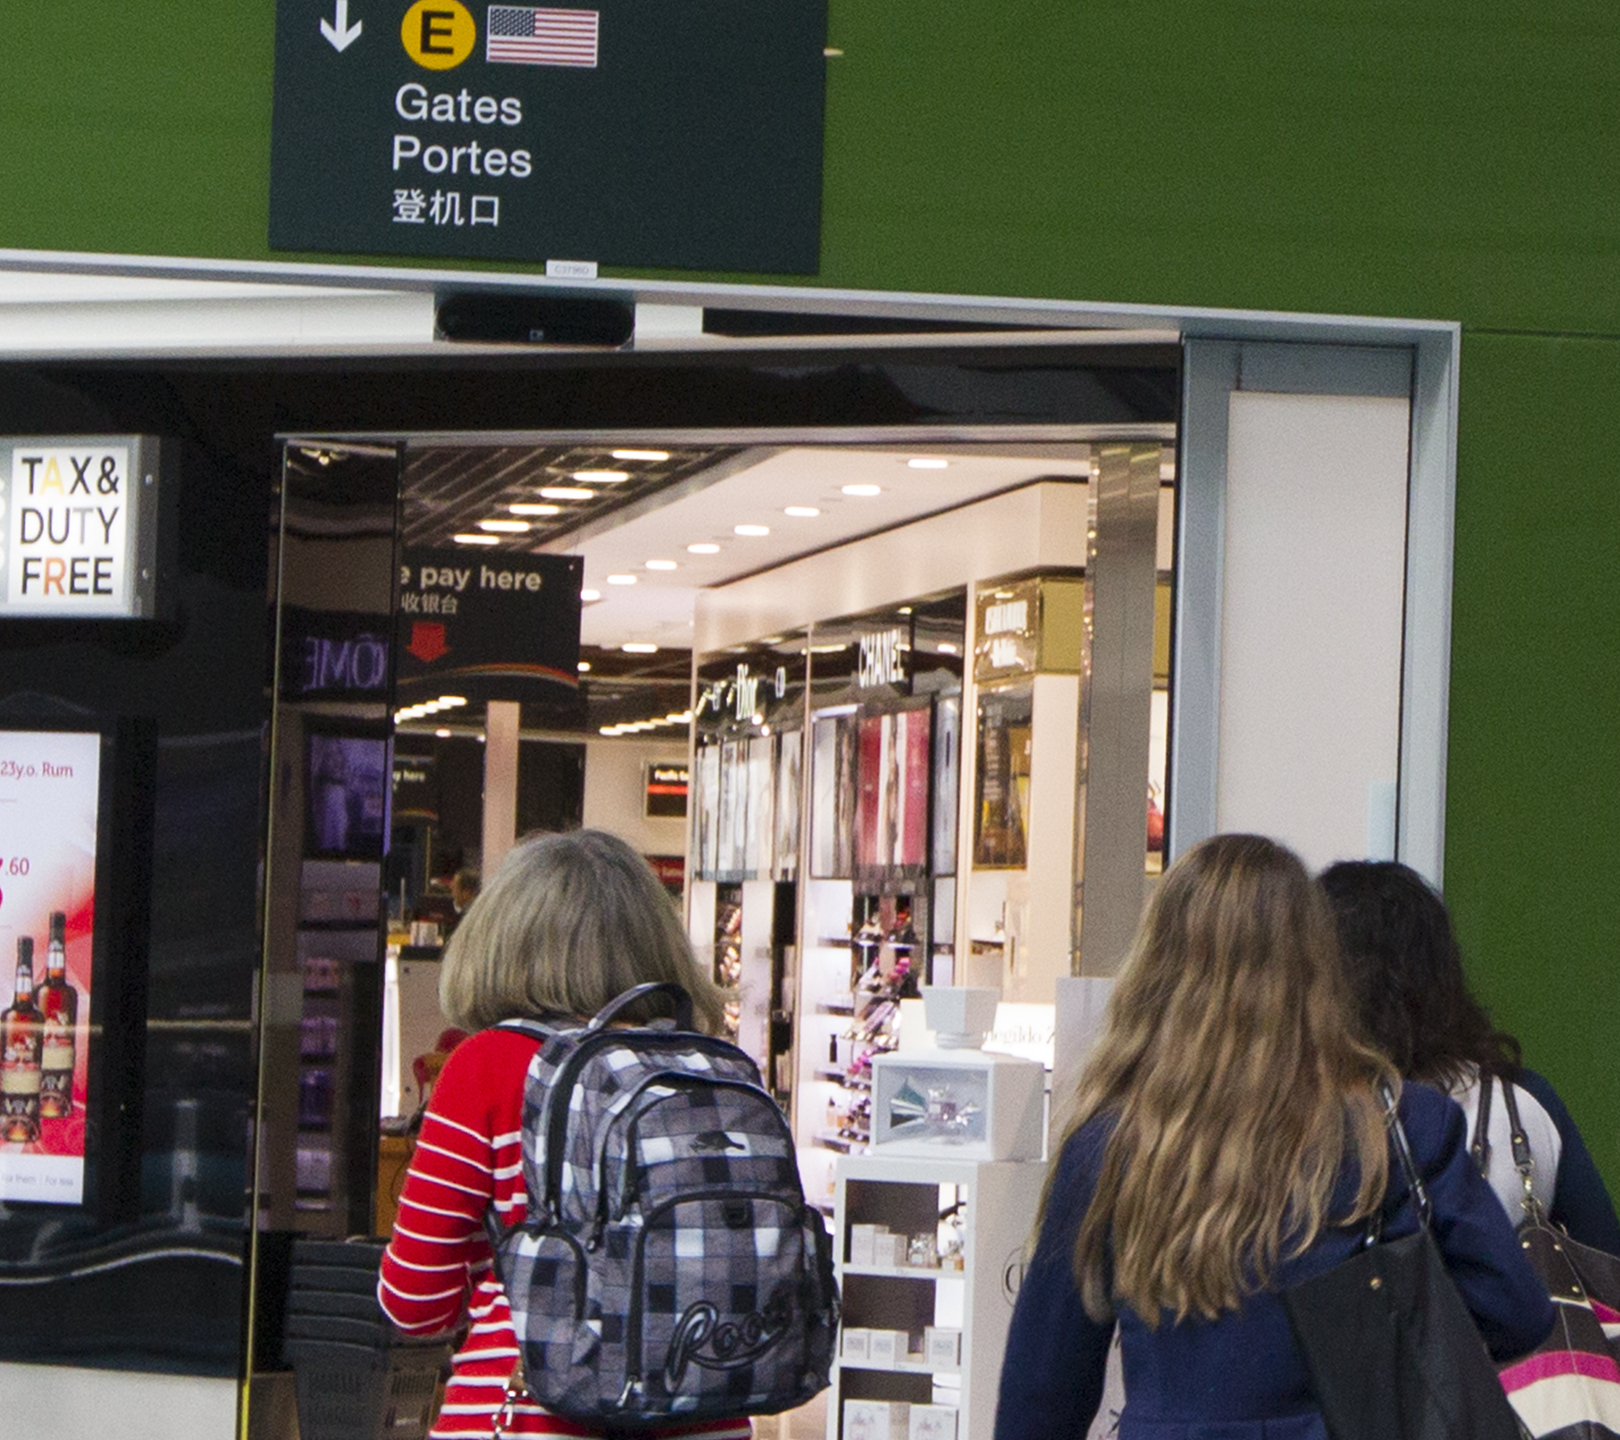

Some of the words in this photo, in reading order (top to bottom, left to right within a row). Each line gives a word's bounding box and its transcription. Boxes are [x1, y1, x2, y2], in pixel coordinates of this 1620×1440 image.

[420, 10, 455, 55] E
[395, 83, 522, 126] Gates
[392, 134, 532, 178] Portes
[392, 188, 500, 227] 登机口
[20, 506, 119, 545] DUTY
[21, 556, 114, 596] FREE
[420, 566, 471, 592] pay
[480, 565, 542, 592] here
[858, 628, 904, 689] CHANEL
[42, 761, 73, 777] Rum
